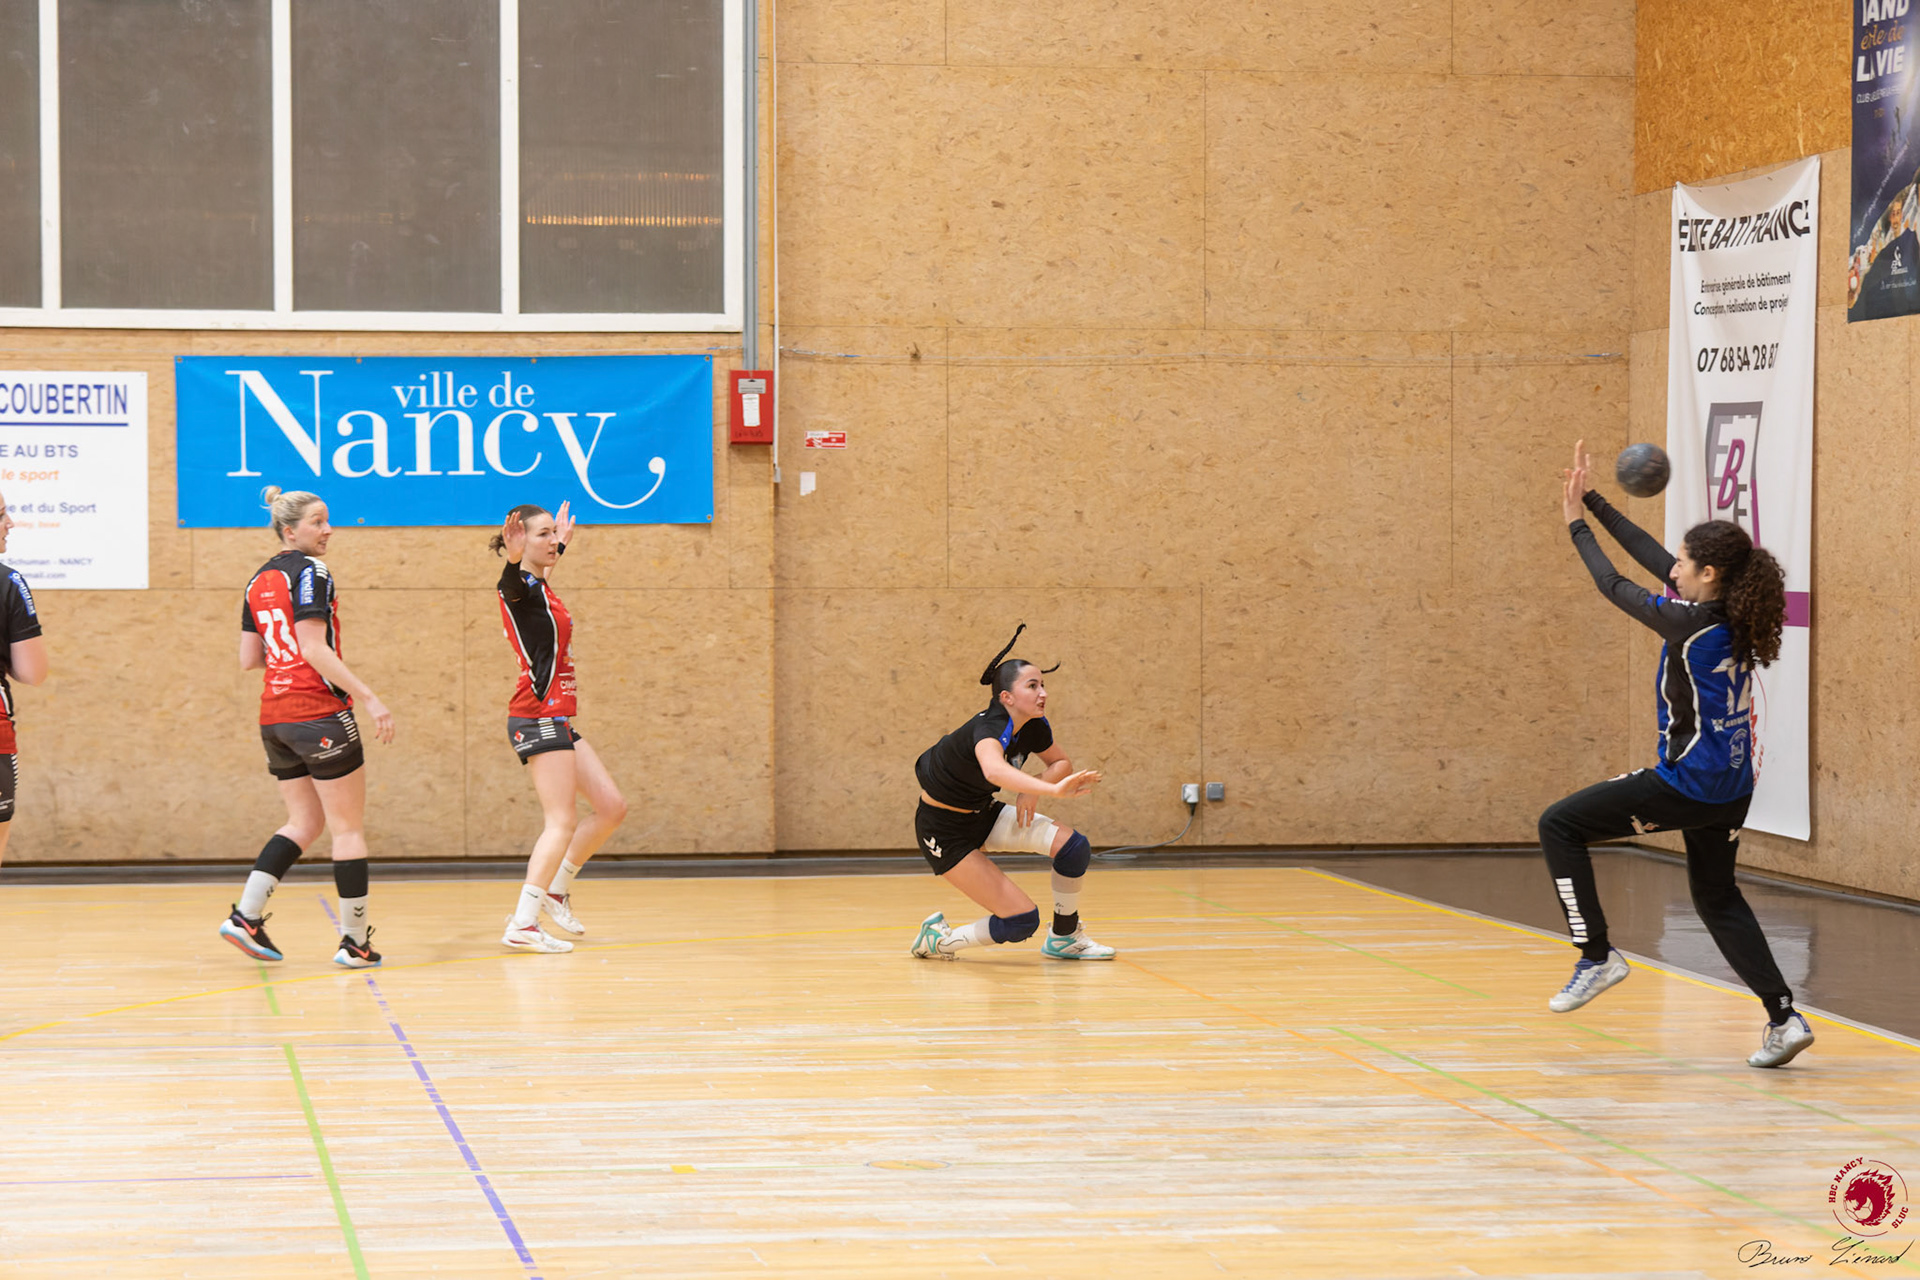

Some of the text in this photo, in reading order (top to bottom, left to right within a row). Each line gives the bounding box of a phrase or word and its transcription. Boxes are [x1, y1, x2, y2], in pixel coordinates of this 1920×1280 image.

[1876, 45, 1905, 77] VIE
[1746, 273, 1755, 289] de
[1755, 271, 1791, 288] bâtiment
[1757, 295, 1768, 311] de
[1697, 347, 1720, 373] 07
[1720, 346, 1735, 372] 68
[1737, 346, 1751, 372] 54
[1752, 344, 1768, 371] 28
[391, 371, 535, 409] ville de
[225, 369, 666, 510] Nancy
[14, 444, 38, 458] AU
[44, 444, 79, 458] BTS
[19, 469, 60, 484] sport
[21, 503, 33, 514] et
[38, 502, 55, 514] du
[59, 501, 96, 515] Sport
